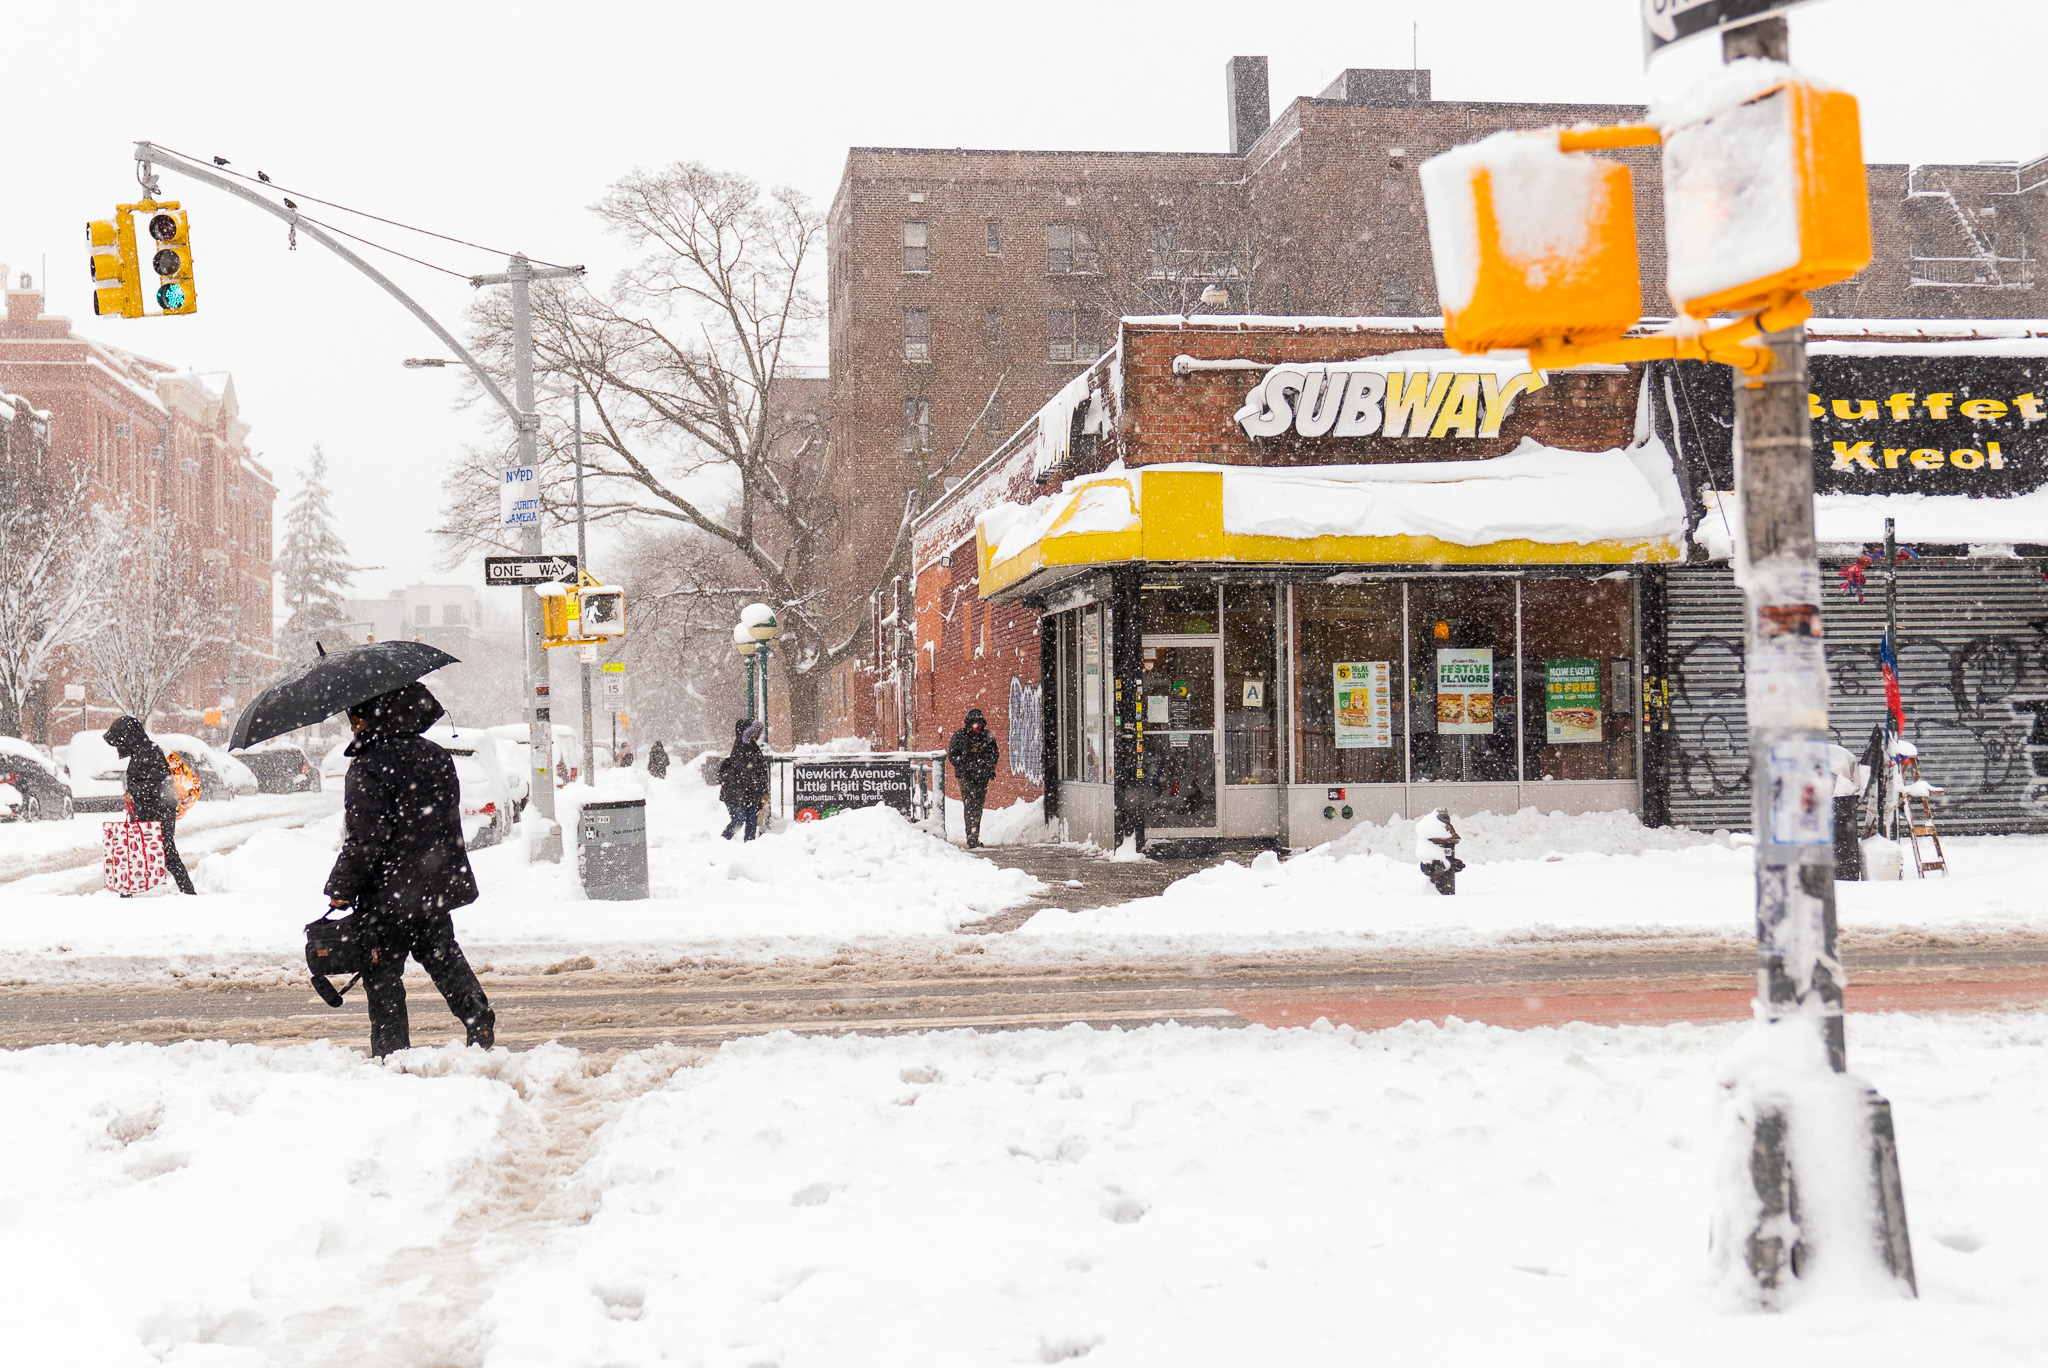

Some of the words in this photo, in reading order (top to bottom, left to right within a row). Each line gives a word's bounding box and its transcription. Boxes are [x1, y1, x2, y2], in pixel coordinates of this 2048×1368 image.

[1240, 370, 1548, 439] SUBWAY
[1807, 392, 2047, 421] Buffet
[1832, 441, 2004, 470] Kreol
[506, 469, 533, 483] NYPD
[493, 565, 523, 577] ONE
[539, 564, 567, 576] WAY
[1440, 664, 1490, 674] FESTIVE
[1549, 667, 1569, 676] NOW
[1570, 666, 1595, 676] EVERY
[1440, 674, 1490, 683] FLAVORS
[608, 685, 619, 694] 15
[1246, 684, 1259, 700] A
[1564, 682, 1596, 693] FREE
[795, 768, 846, 779] Newkirk
[849, 767, 901, 779] Avenue-
[796, 781, 827, 792] Little
[831, 780, 859, 792] Haiti
[862, 780, 907, 791] Station
[802, 811, 813, 823] 2
